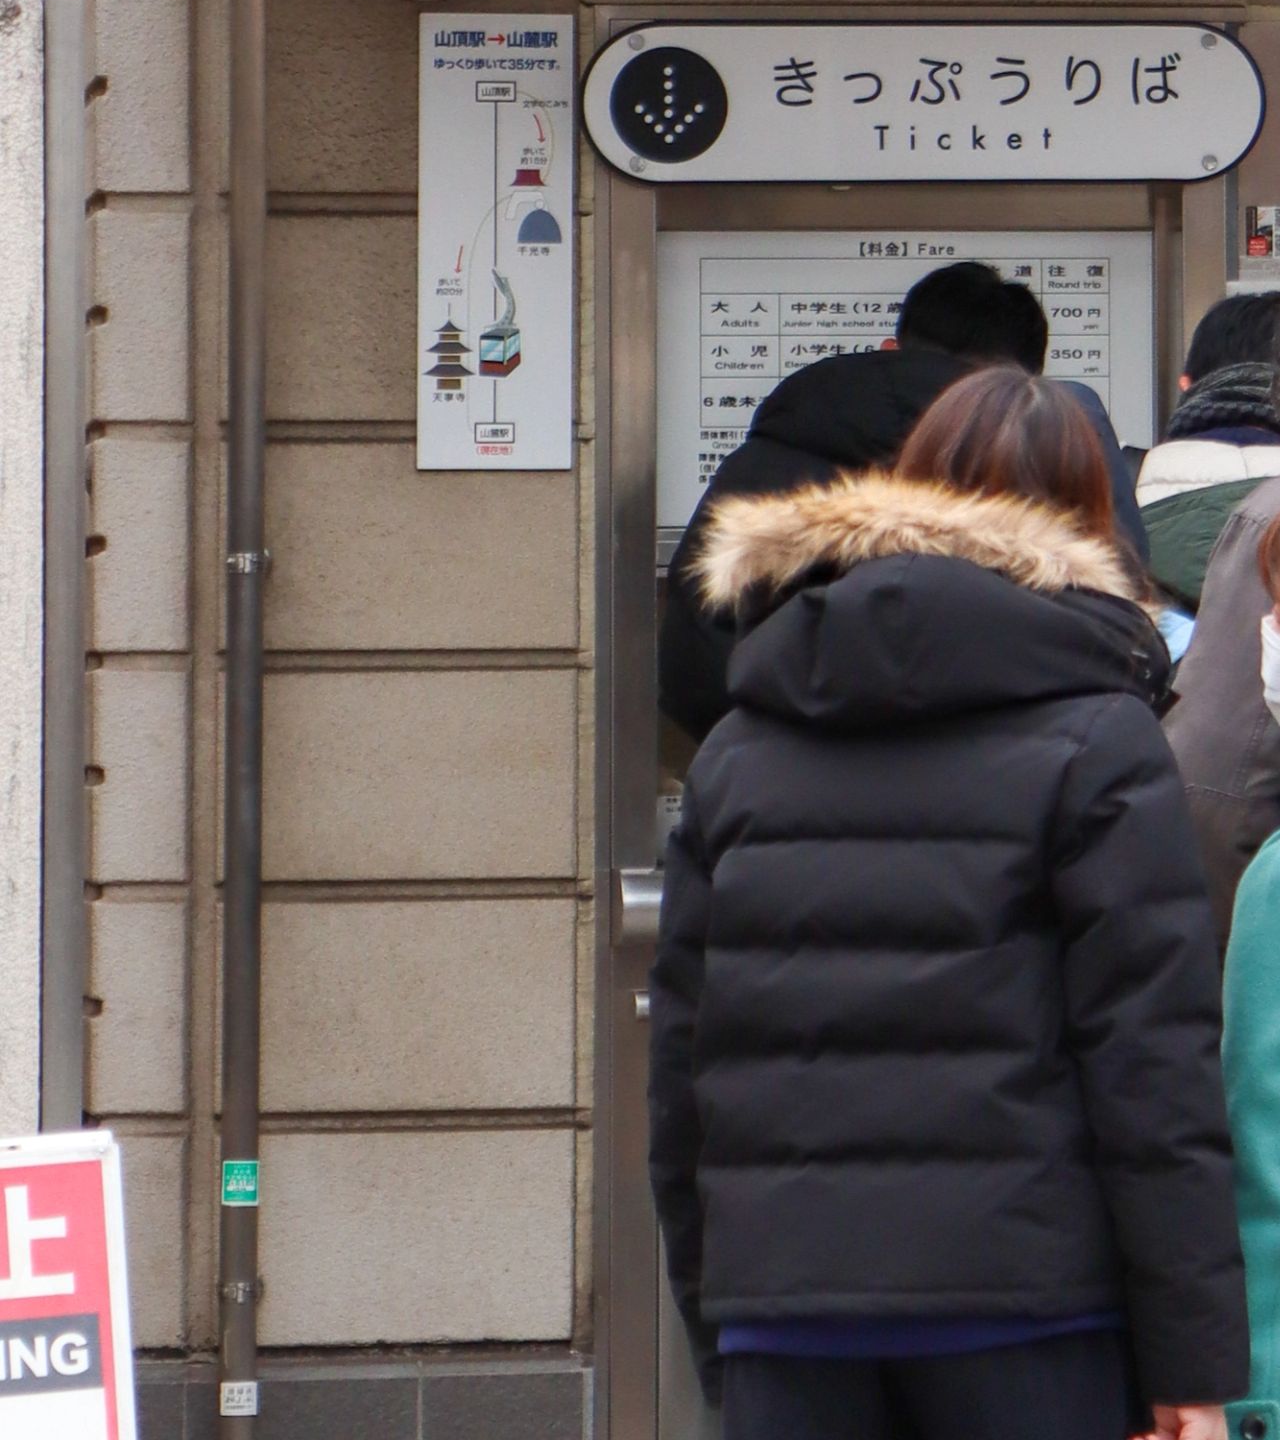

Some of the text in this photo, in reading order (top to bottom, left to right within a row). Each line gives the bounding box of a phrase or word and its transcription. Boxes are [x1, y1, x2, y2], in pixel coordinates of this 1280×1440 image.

[434, 30, 558, 48] 山頂駅 山麓駅
[774, 52, 1183, 107] きっぷうりば
[874, 125, 1053, 151] Ticket
[917, 243, 955, 256] Fare
[1048, 280, 1102, 290] Round trip
[720, 319, 760, 328] Adults
[816, 319, 838, 330] high
[841, 319, 875, 328] school
[714, 361, 764, 370] Children
[703, 396, 764, 408] 6歳未
